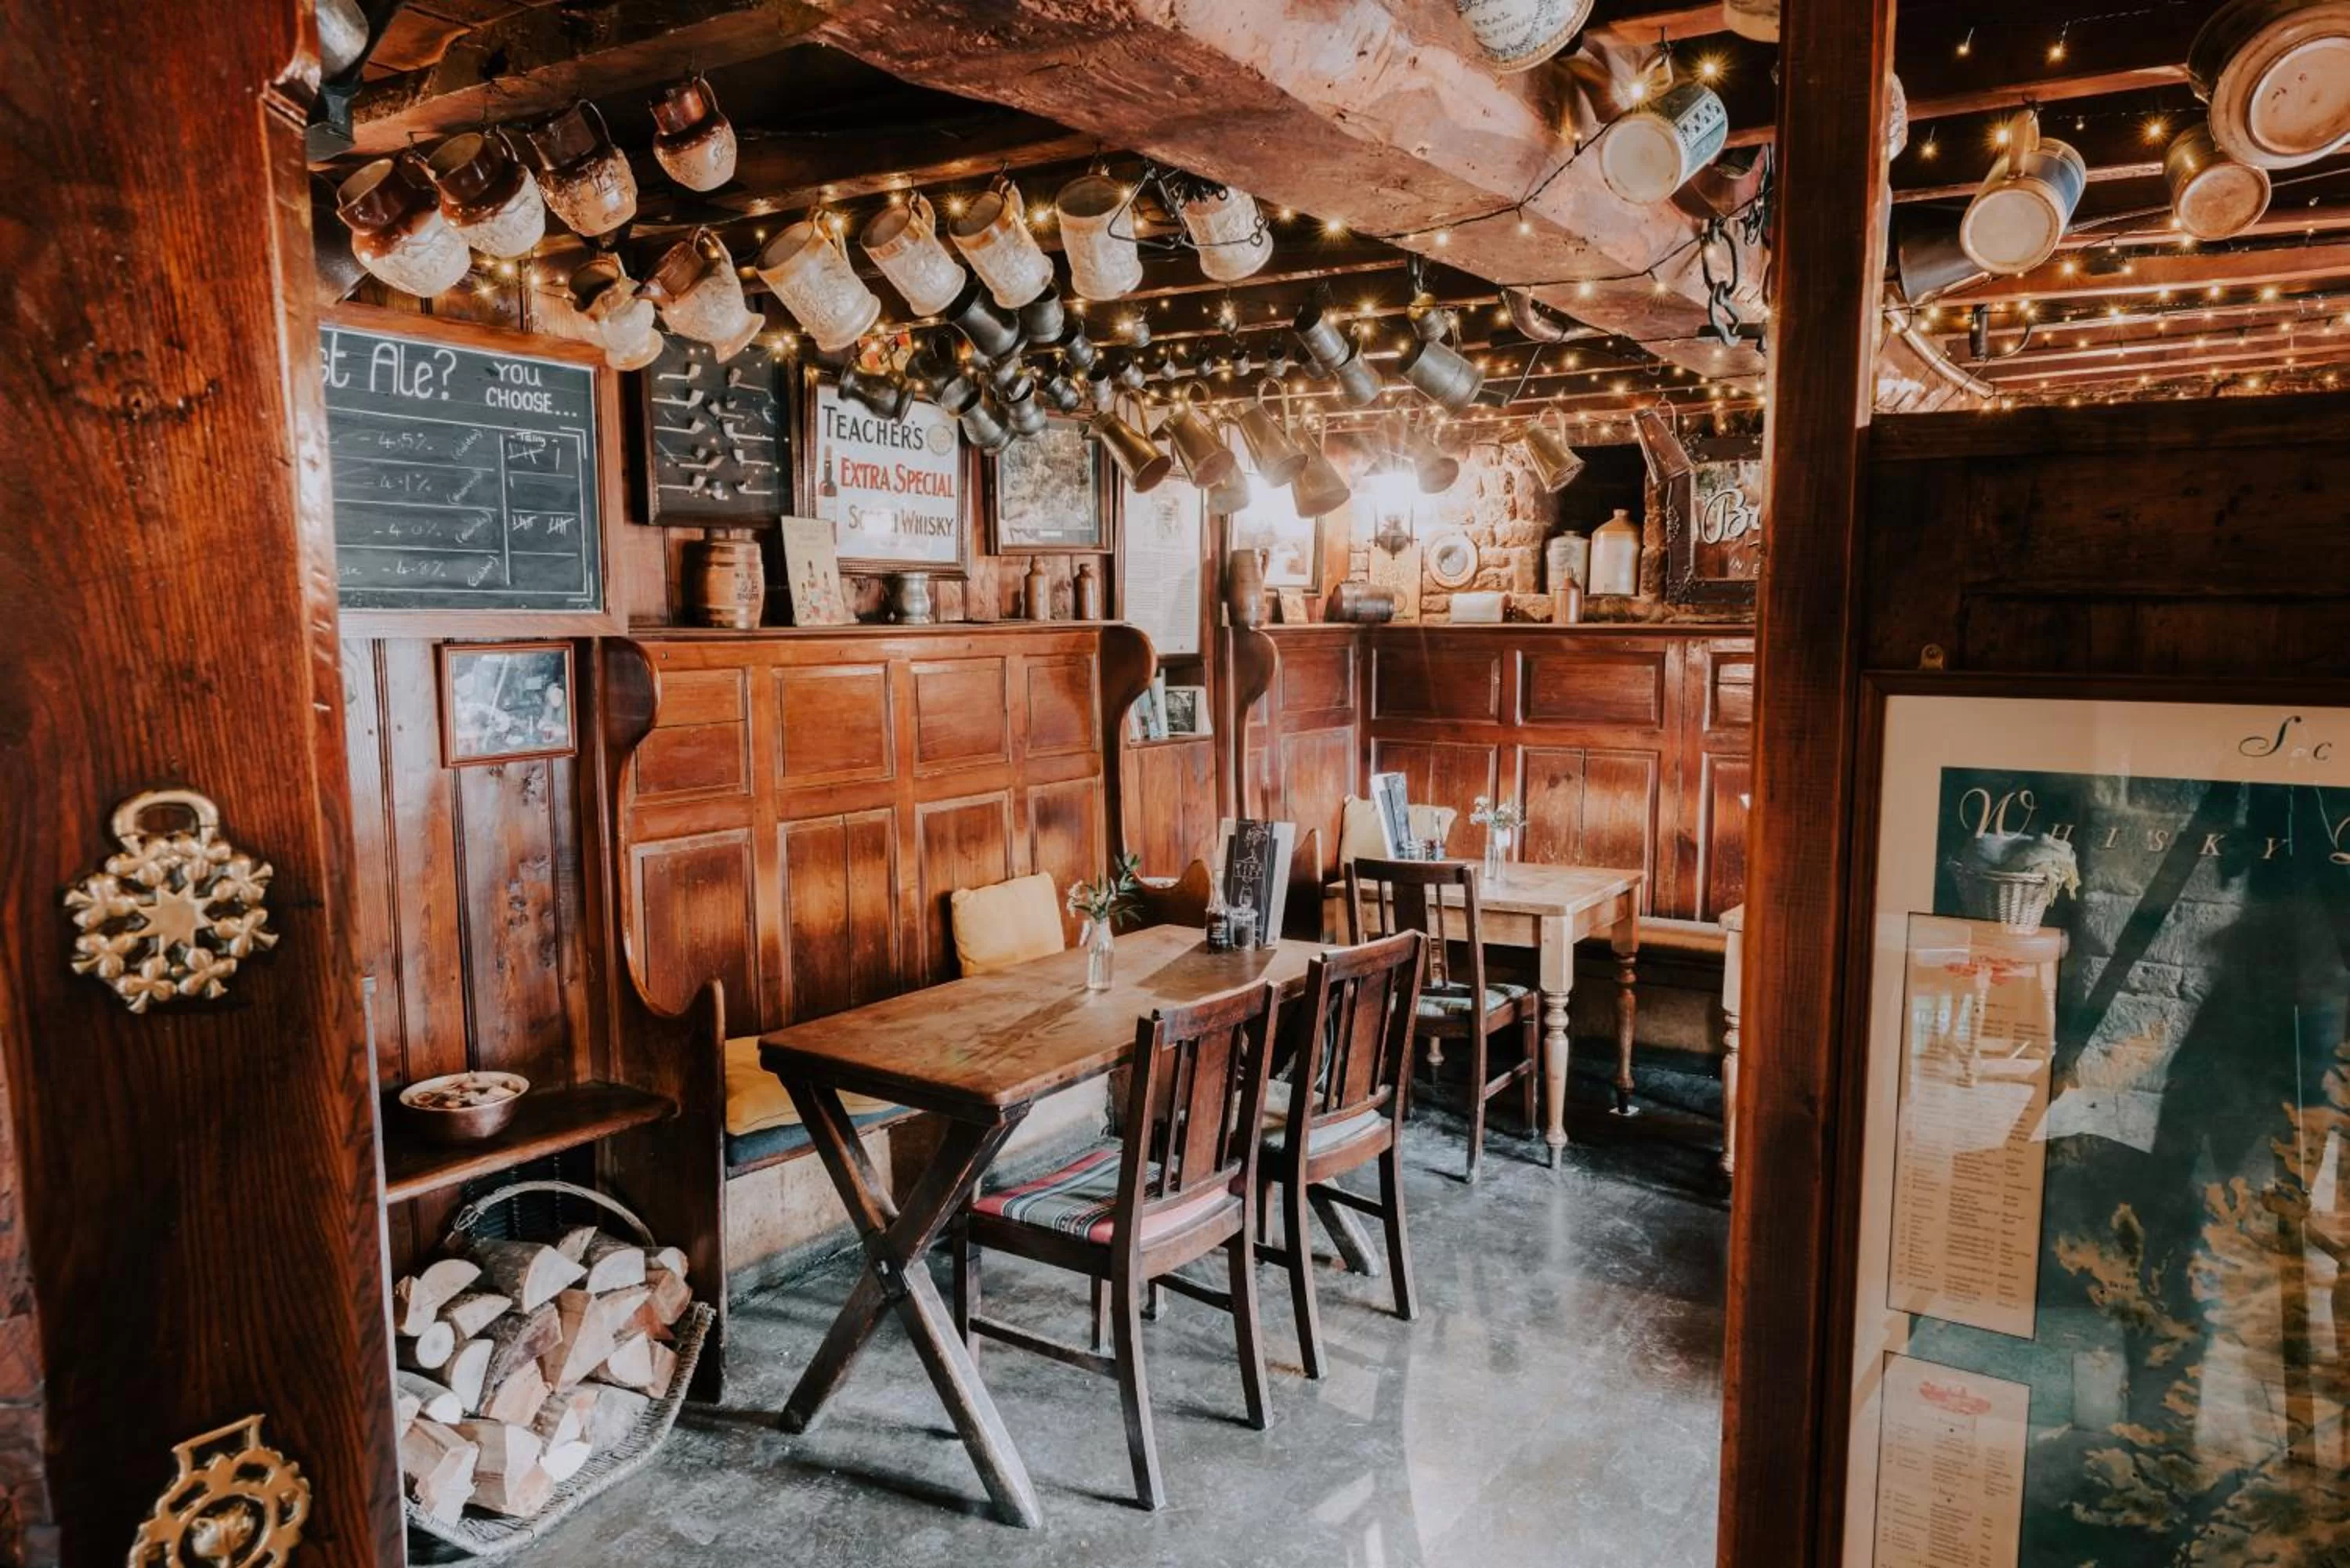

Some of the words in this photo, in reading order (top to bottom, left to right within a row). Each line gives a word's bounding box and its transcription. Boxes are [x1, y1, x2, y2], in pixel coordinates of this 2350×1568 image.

[371, 342, 457, 400] Ale?
[493, 361, 542, 387] YOU
[822, 404, 924, 451] TEACHER'S
[840, 457, 891, 492] EXTRA
[893, 463, 955, 498] SPECIAL
